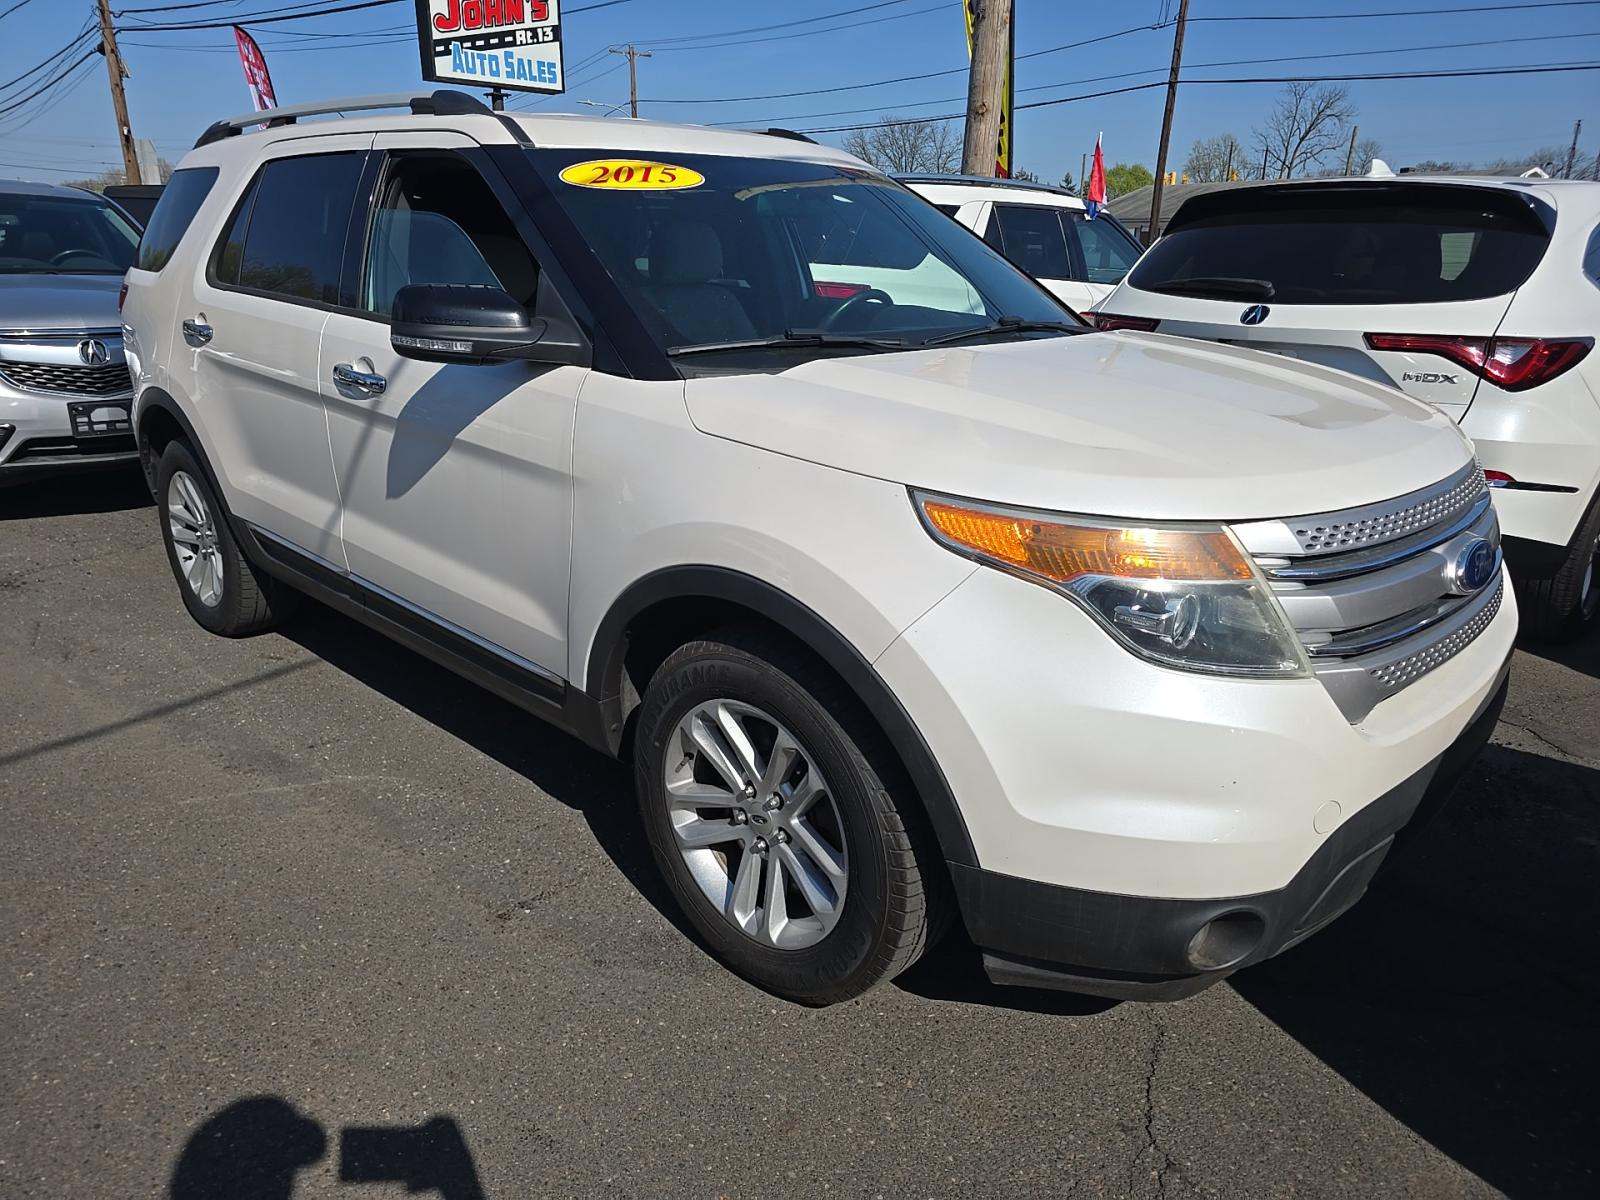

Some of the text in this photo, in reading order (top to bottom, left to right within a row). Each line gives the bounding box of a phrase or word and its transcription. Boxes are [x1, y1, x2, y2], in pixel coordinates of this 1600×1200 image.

[433, 0, 549, 32] JOHNS
[452, 43, 557, 84] AUTO SALES
[590, 166, 677, 185] 2015
[1402, 372, 1459, 384] MDX
